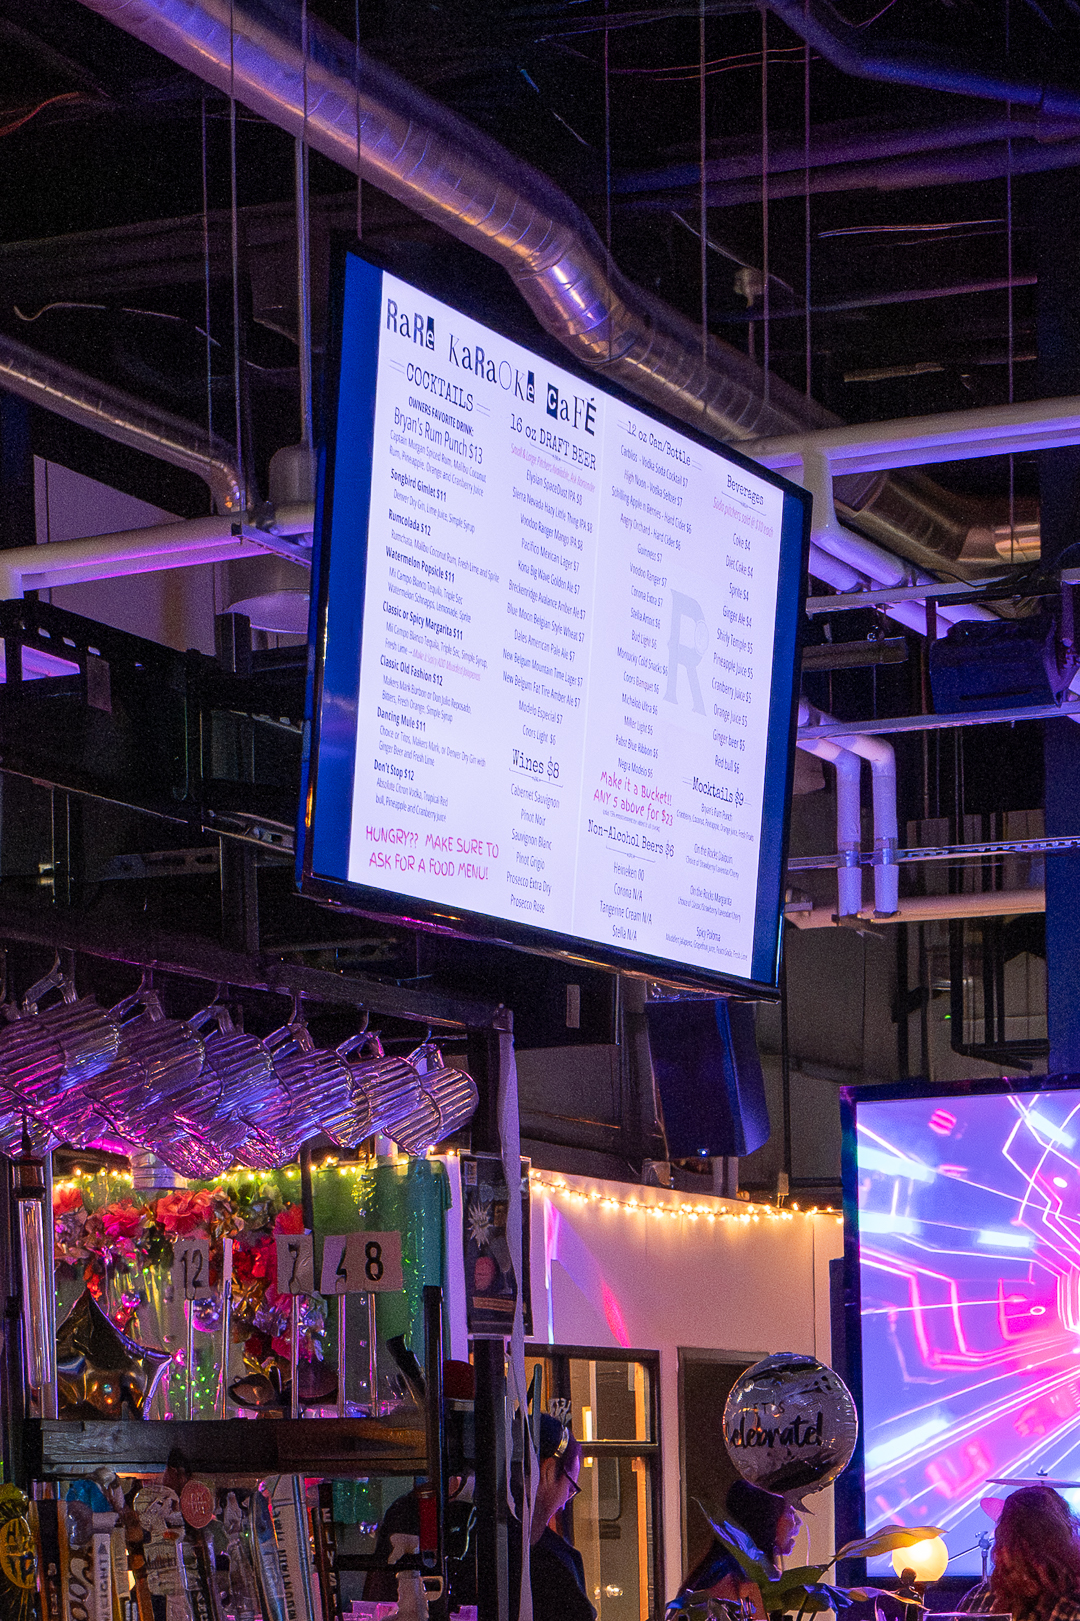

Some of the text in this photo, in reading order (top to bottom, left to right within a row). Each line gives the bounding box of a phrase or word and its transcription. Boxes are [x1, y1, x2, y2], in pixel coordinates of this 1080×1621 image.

[406, 362, 474, 412] COCKTAILS
[394, 406, 484, 465] Bryan's Rum Punch $13
[510, 412, 597, 471] 16 oz DRAFT BEER
[626, 420, 691, 467] 12 oz Can/Bottle
[390, 468, 447, 503] Songbird Gimlet $11
[727, 474, 764, 506] Beverages
[388, 508, 432, 537] Rumcolada $12
[421, 560, 445, 580] Popsicle
[444, 569, 456, 583] $11
[382, 600, 464, 641] Classic or Spicy Margarita $11
[380, 654, 444, 687] Classic Old Fashion $12
[377, 706, 427, 732] Dancing Mule $11
[373, 758, 415, 782] Don't Stop $12
[512, 748, 561, 781] Wines $8
[510, 783, 561, 810] Cabernet Sauvignon
[600, 771, 673, 807] Make it a Bucket!!
[692, 776, 745, 809] Mocktails $9
[520, 808, 547, 827] Pinot Noir
[593, 788, 612, 805] ANY
[612, 796, 619, 809] 5
[620, 799, 646, 817] above
[646, 802, 660, 821] for
[661, 809, 674, 827] $23
[365, 826, 500, 859] HUNGRY?? MAKE SURE TO
[511, 828, 553, 851] Sauvignon Blanc
[587, 819, 640, 848] Non-Alcohol
[641, 835, 665, 855] Beers
[664, 840, 675, 859] $6
[368, 851, 489, 881] ASK FOR A FOOD MENU!
[515, 851, 546, 873] Pinot Grigio
[506, 870, 553, 897] Prosecco Extra Dry
[510, 893, 546, 914] Prosecco Rose
[599, 899, 653, 925] Tangerine Cream N/A
[612, 924, 638, 941] Stella N/A
[180, 1248, 203, 1289] 12
[365, 1241, 384, 1281] 8
